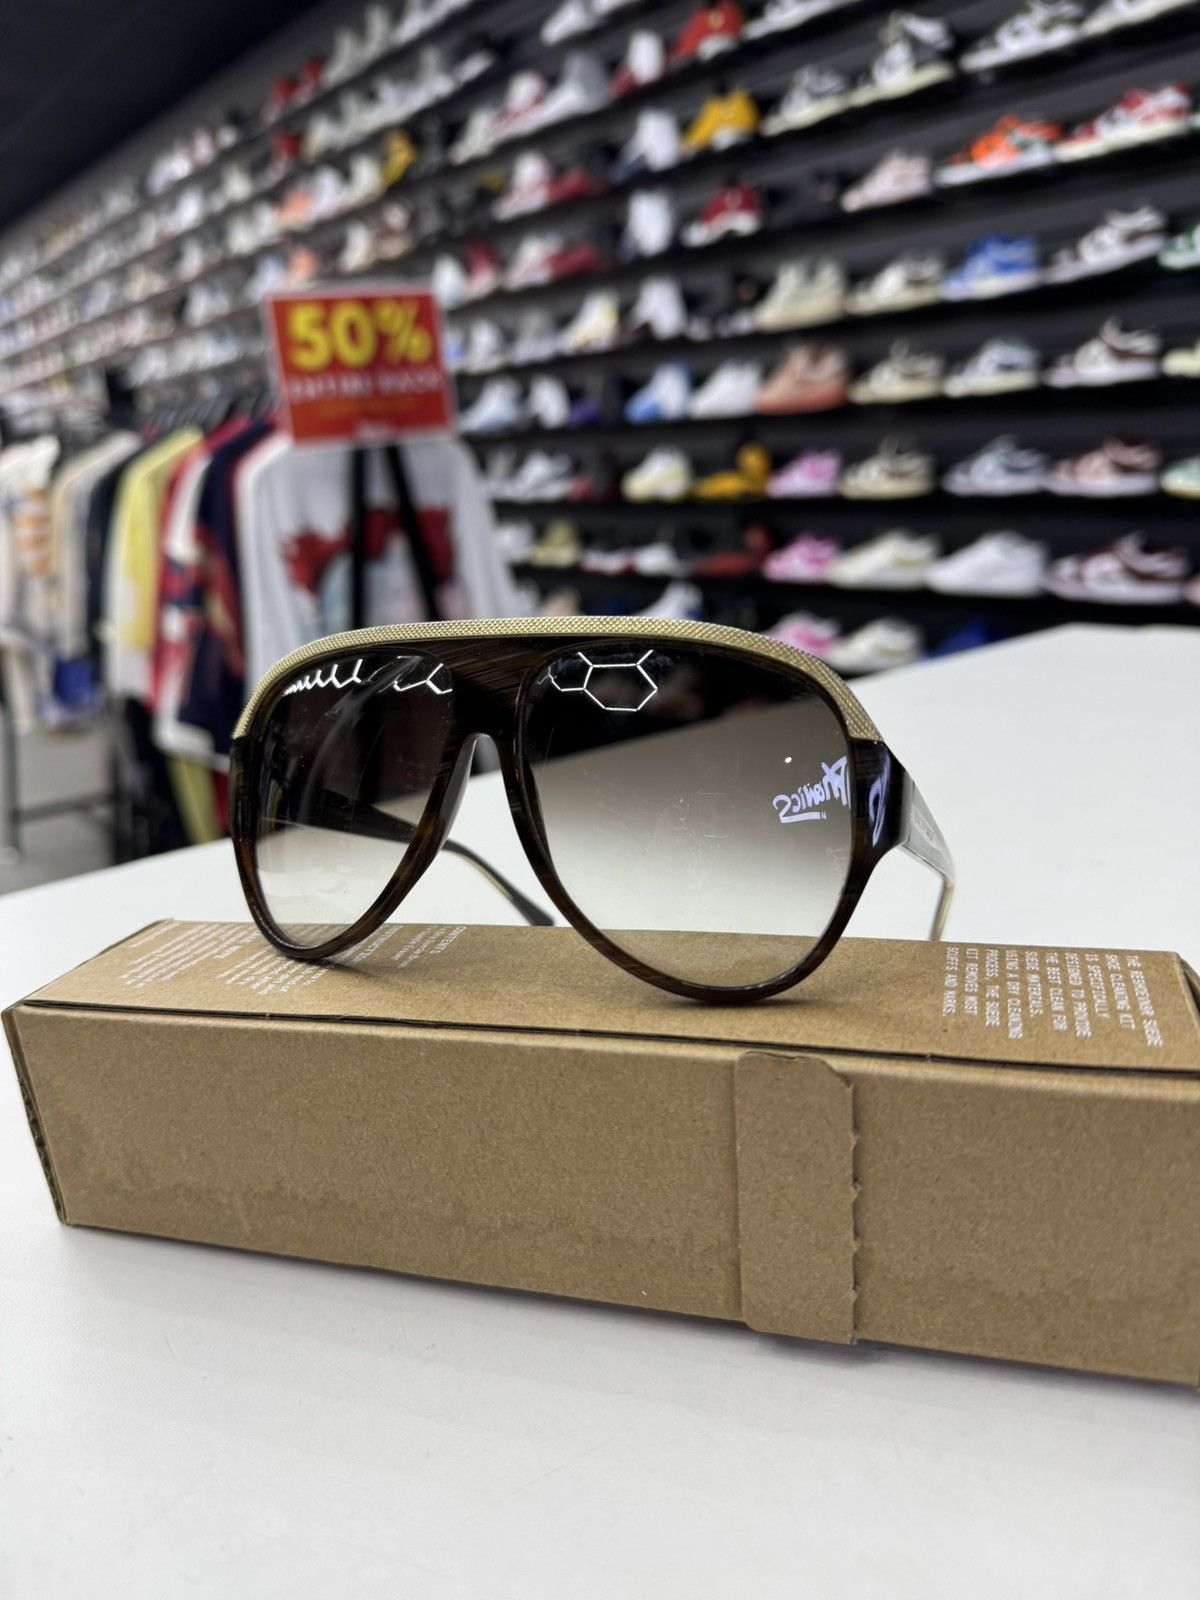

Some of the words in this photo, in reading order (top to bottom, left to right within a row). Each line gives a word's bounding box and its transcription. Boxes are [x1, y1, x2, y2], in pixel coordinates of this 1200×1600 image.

[289, 302, 432, 371] 50%
[966, 948, 978, 959] KIT
[1006, 949, 1018, 969] USING
[1045, 952, 1057, 963] THE
[1085, 953, 1098, 961] IS
[1126, 955, 1140, 968] THE
[1065, 952, 1082, 985] DESIGNED
[1104, 954, 1120, 970] SHOE
[944, 974, 957, 987] AND
[1047, 967, 1061, 984] BEST
[986, 984, 998, 998] THE
[1007, 981, 1019, 994] DRY
[1070, 988, 1084, 999] TO
[1087, 965, 1109, 1018] SPECIFICALLY
[1109, 973, 1130, 1010] CLEANING
[963, 995, 977, 1015] MOST
[1049, 987, 1064, 1011] CLEAN
[1118, 1013, 1135, 1029] KIT
